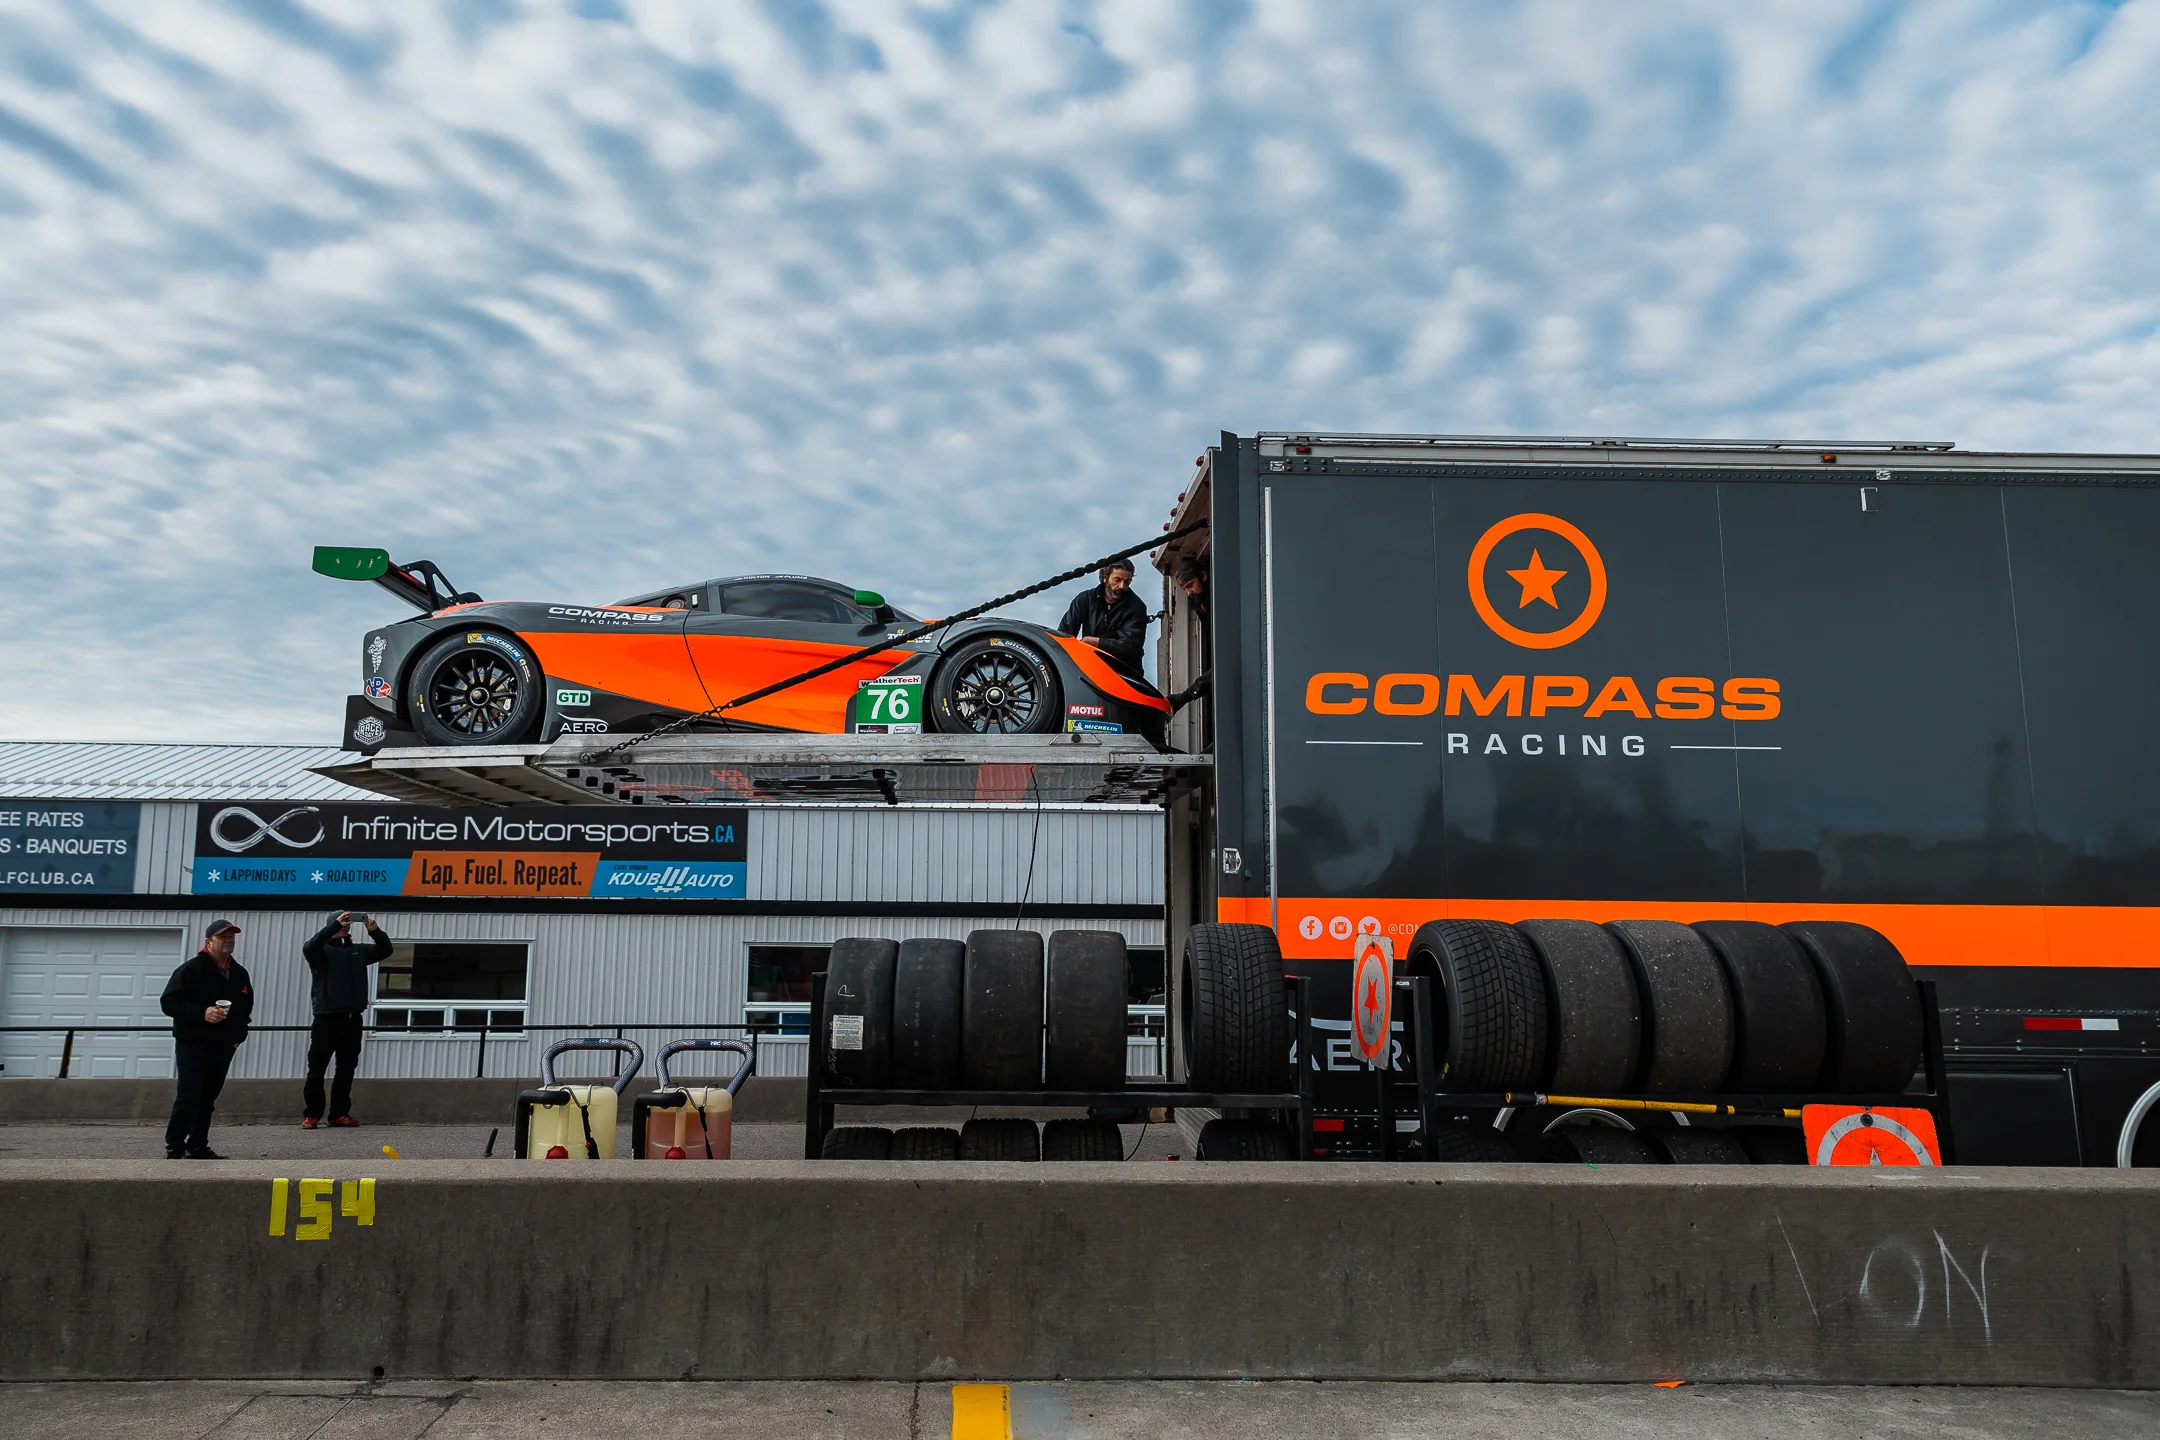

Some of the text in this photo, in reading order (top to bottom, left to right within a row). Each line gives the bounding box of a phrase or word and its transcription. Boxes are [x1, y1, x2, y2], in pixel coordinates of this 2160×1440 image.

[548, 607, 664, 621] COMPASS
[486, 635, 521, 658] MICHELIN
[558, 691, 590, 703] GTD
[867, 688, 910, 720] 76
[1305, 672, 1782, 721] COMPASS
[1070, 706, 1103, 715] MOTUL
[360, 723, 380, 735] RACE
[560, 723, 608, 733] AERO
[1084, 724, 1118, 732] MICHELIN
[1447, 732, 1647, 757] RACING
[0, 811, 84, 828] EE RATES
[342, 815, 457, 841] Infinite
[26, 838, 127, 855] BANQUETS
[326, 869, 355, 883] ROAD
[357, 870, 387, 883] TRIPS
[421, 858, 583, 892] Lap. Fuel. Repeat.
[608, 872, 734, 888] KDUB AUTO
[268, 1177, 377, 1240] 154
